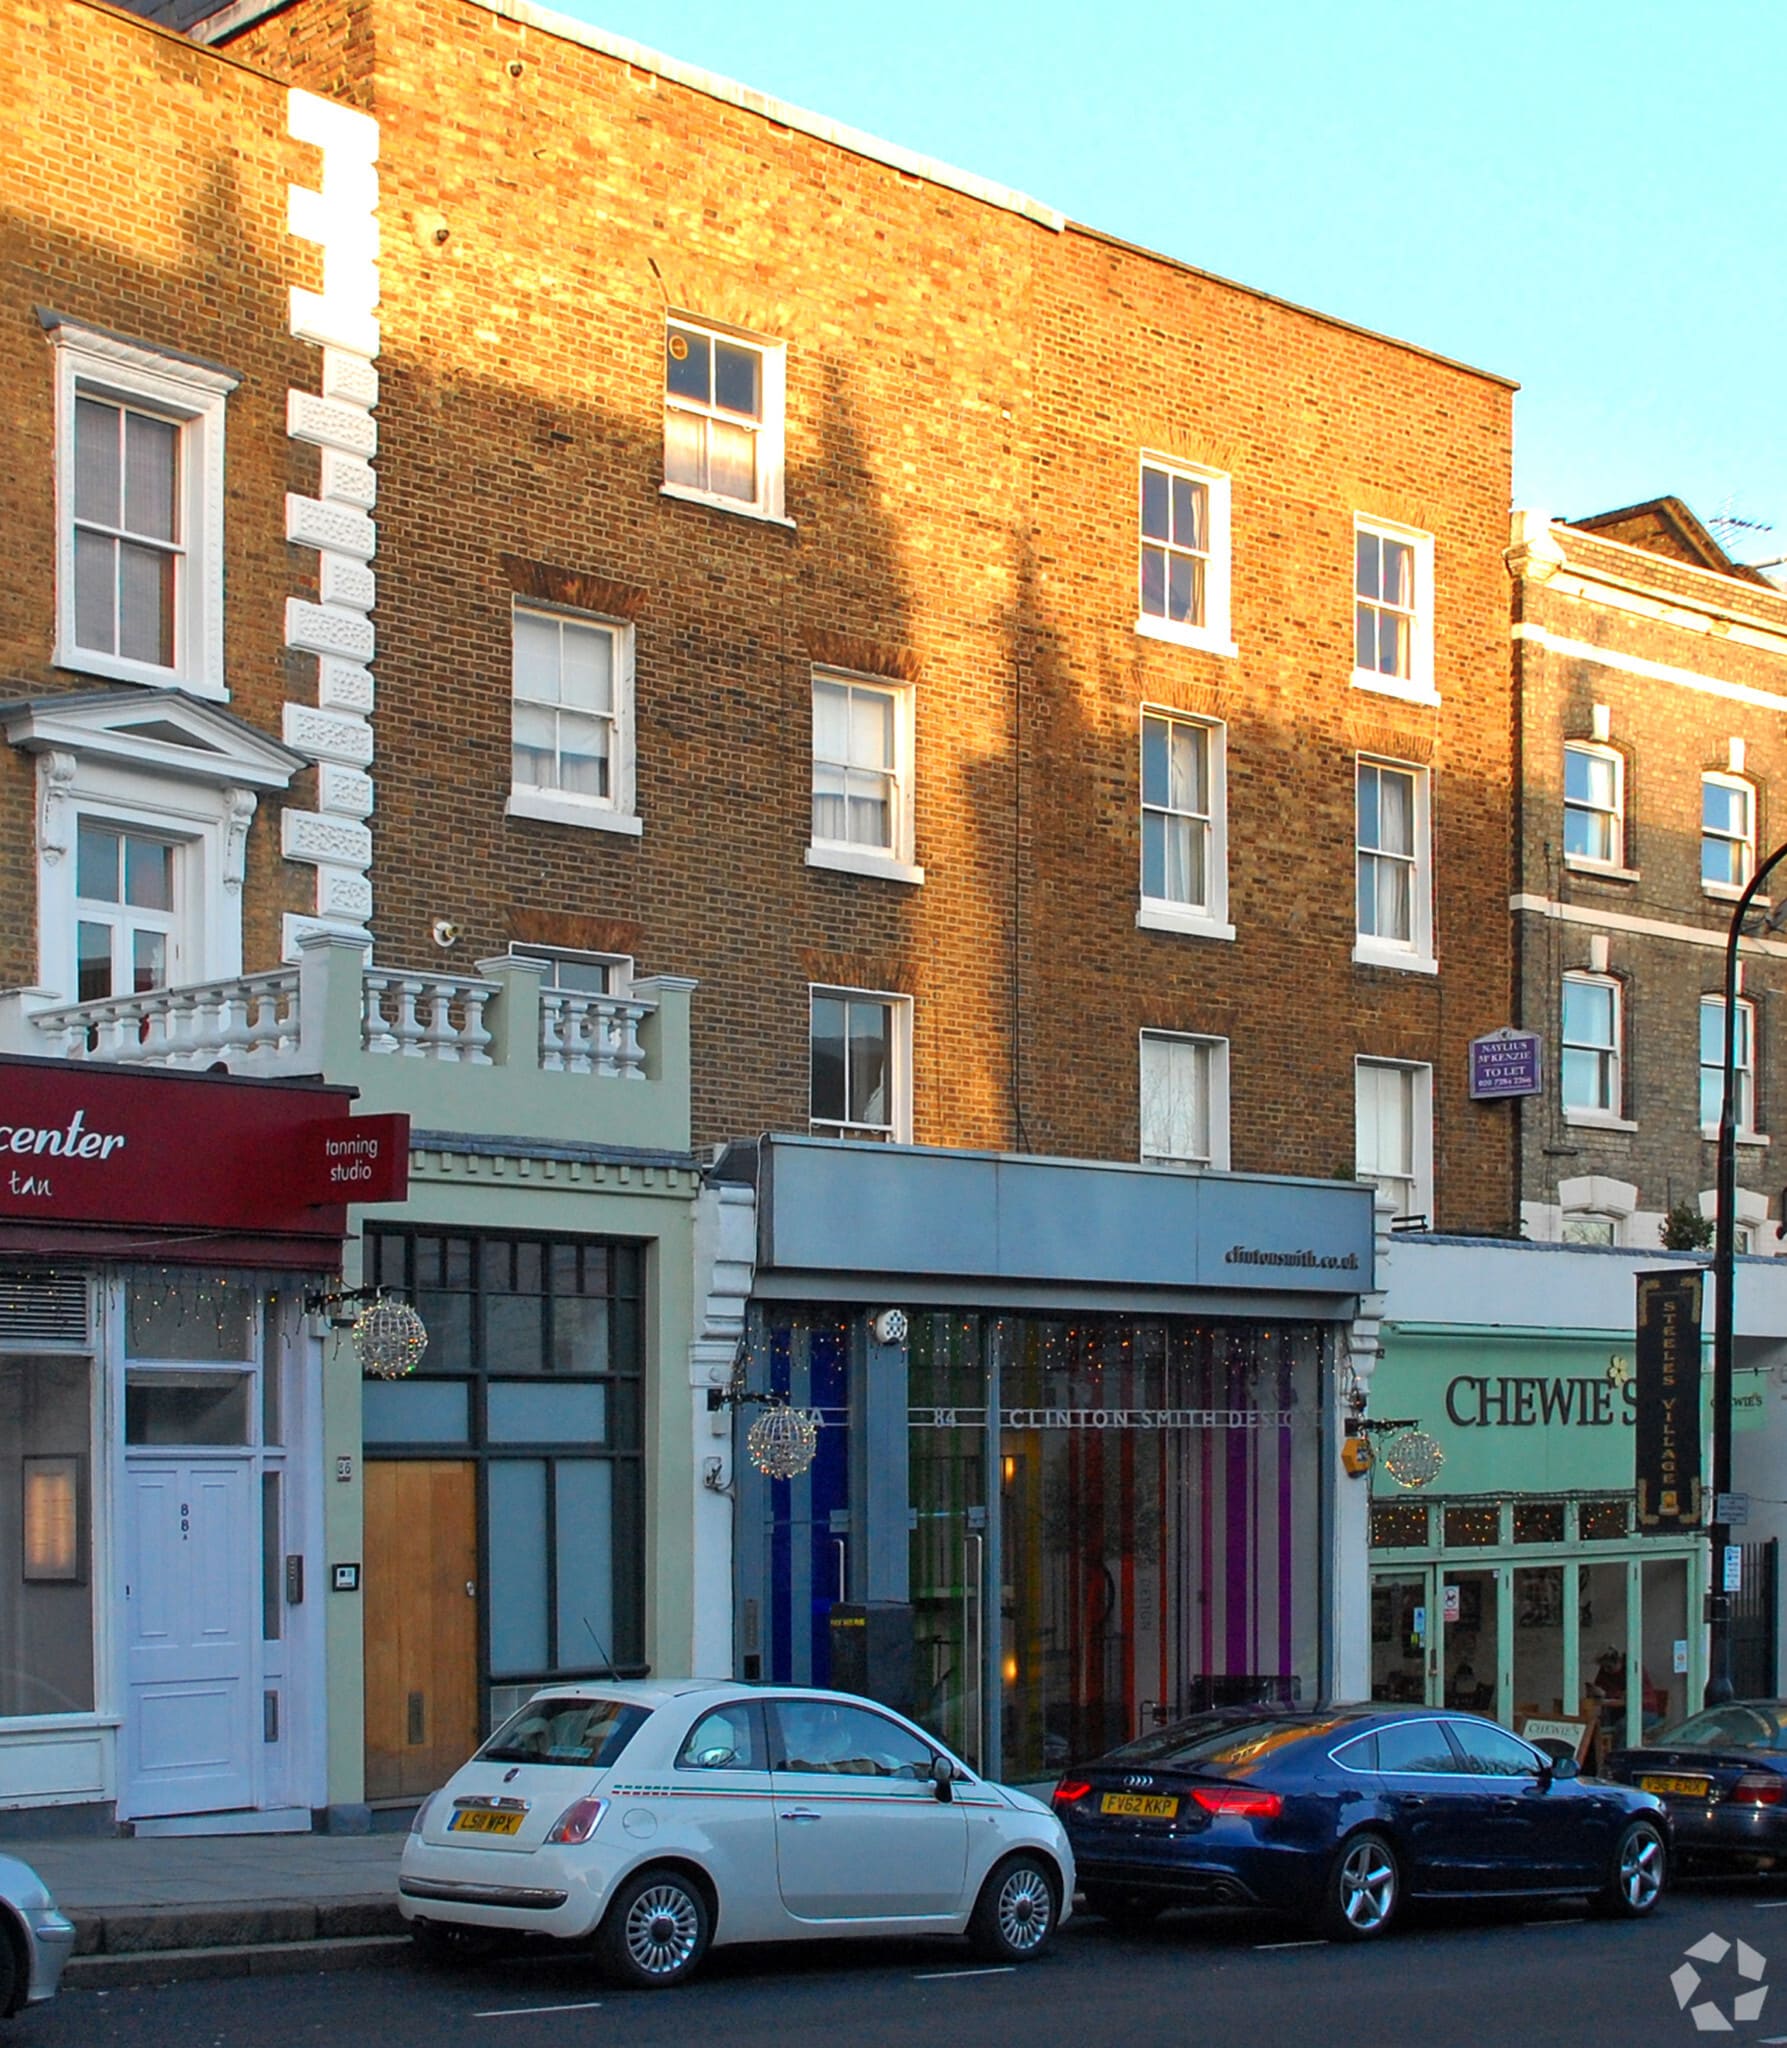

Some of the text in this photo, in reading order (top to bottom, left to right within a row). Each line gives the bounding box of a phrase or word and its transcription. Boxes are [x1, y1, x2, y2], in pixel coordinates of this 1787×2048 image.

[1484, 1066, 1526, 1077] TO LET
[325, 1133, 378, 1159] tanning
[330, 1159, 372, 1181] studio
[8, 1169, 53, 1196] tan
[1225, 1245, 1359, 1270] clintonsmith.co.uk
[1663, 1301, 1677, 1386] STEELES
[934, 1408, 957, 1428] 84
[1010, 1408, 1129, 1428] CLINTON
[1142, 1409, 1215, 1429] SMITH
[1107, 1795, 1172, 1814] FV62 KKP
